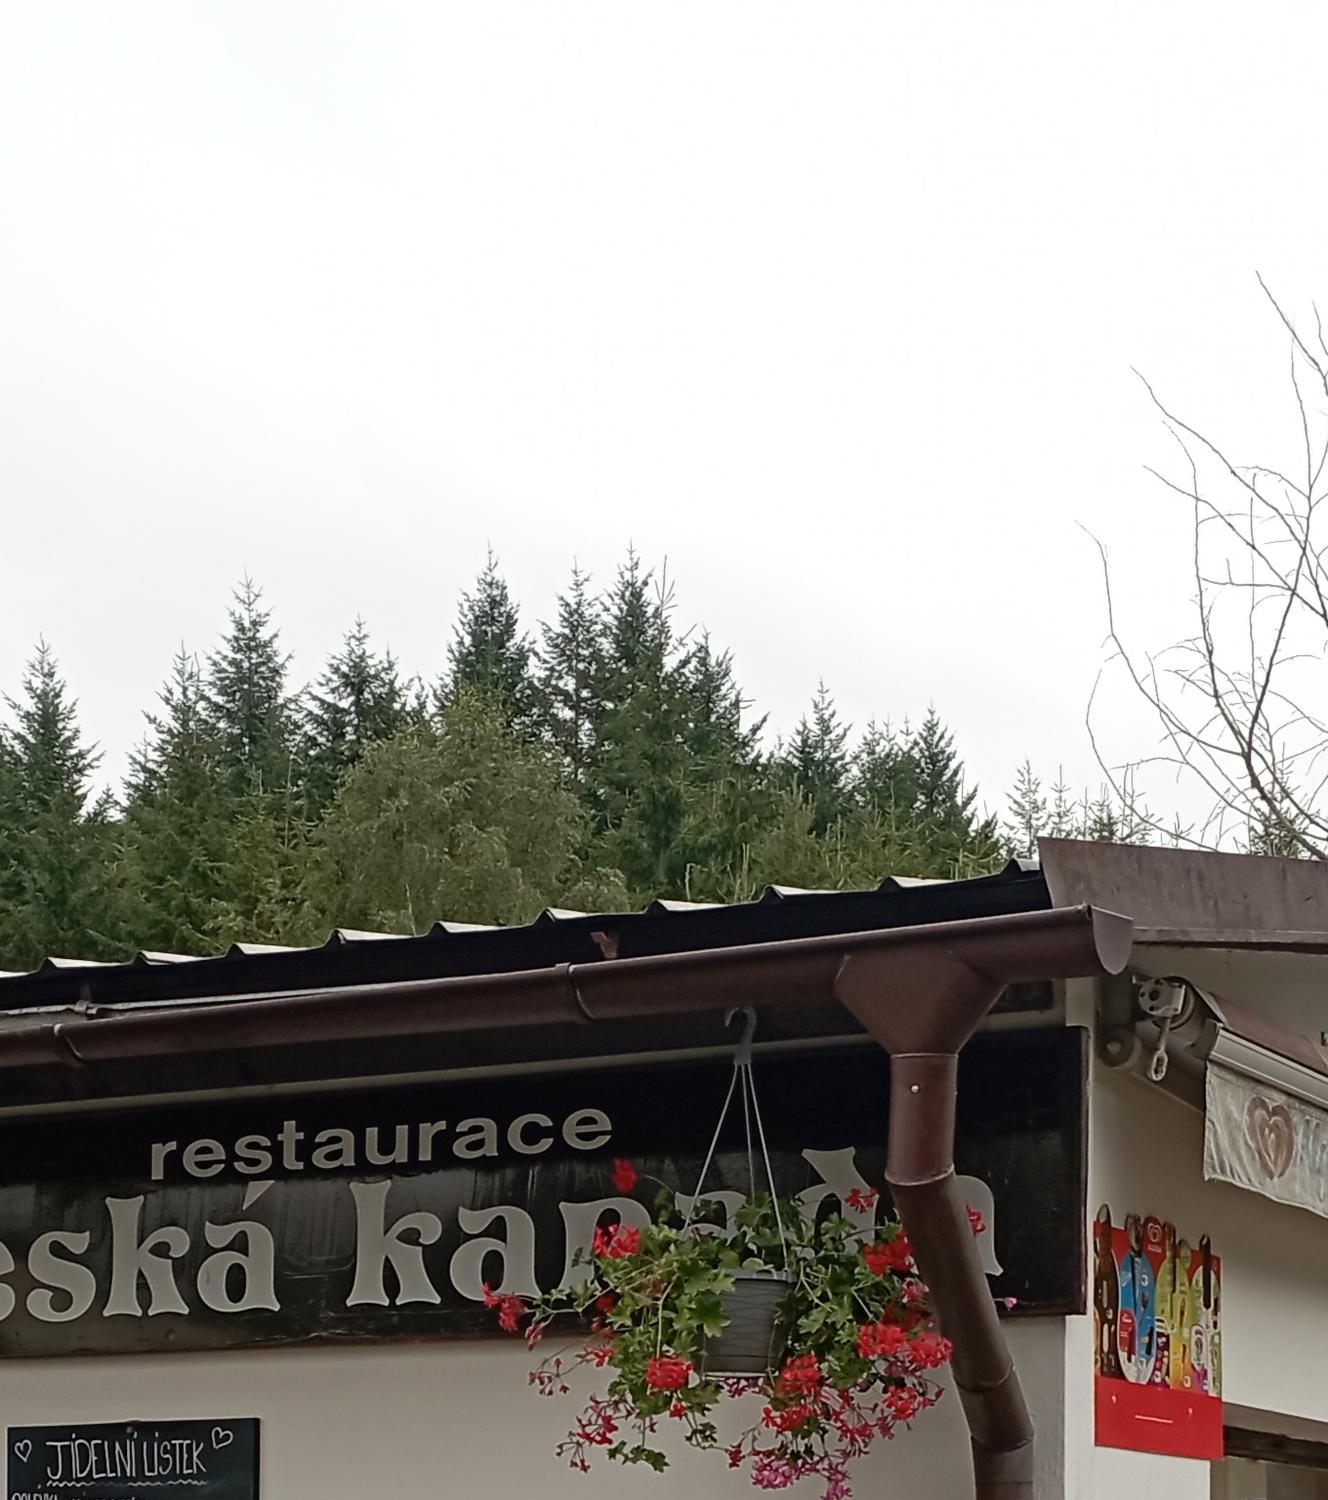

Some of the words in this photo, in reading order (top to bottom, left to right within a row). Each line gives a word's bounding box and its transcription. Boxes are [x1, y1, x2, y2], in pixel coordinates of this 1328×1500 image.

[149, 1105, 614, 1181] restaurace
[45, 1432, 137, 1480] JÍDELNÍ
[143, 1431, 207, 1477] LÍSTEK
